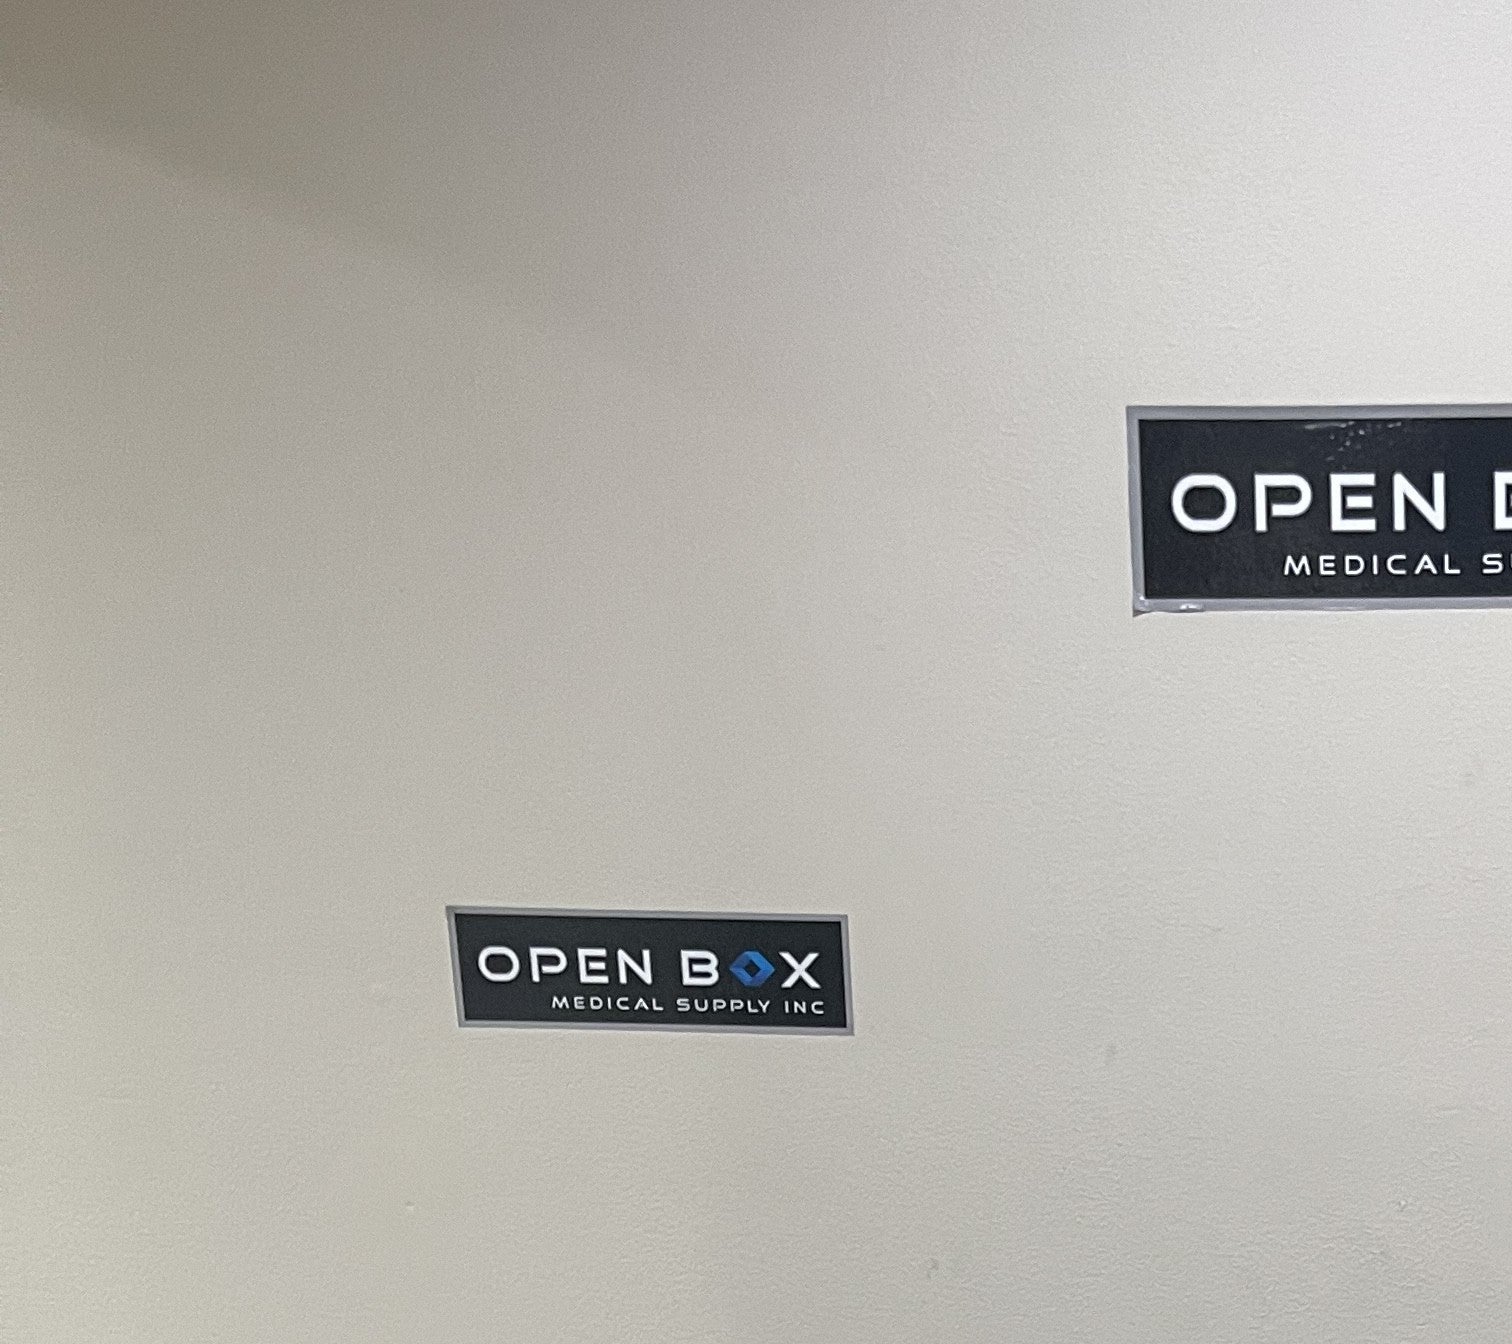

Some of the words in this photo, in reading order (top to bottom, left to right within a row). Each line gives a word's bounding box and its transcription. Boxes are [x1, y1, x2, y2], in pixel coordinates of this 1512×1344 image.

[1171, 471, 1446, 533] OPEN
[1283, 553, 1461, 576] MEDICAL
[477, 945, 653, 985] OPEN
[551, 995, 664, 1011] MEDICAL
[676, 997, 771, 1014] SUPPLY
[784, 1000, 824, 1015] INC
